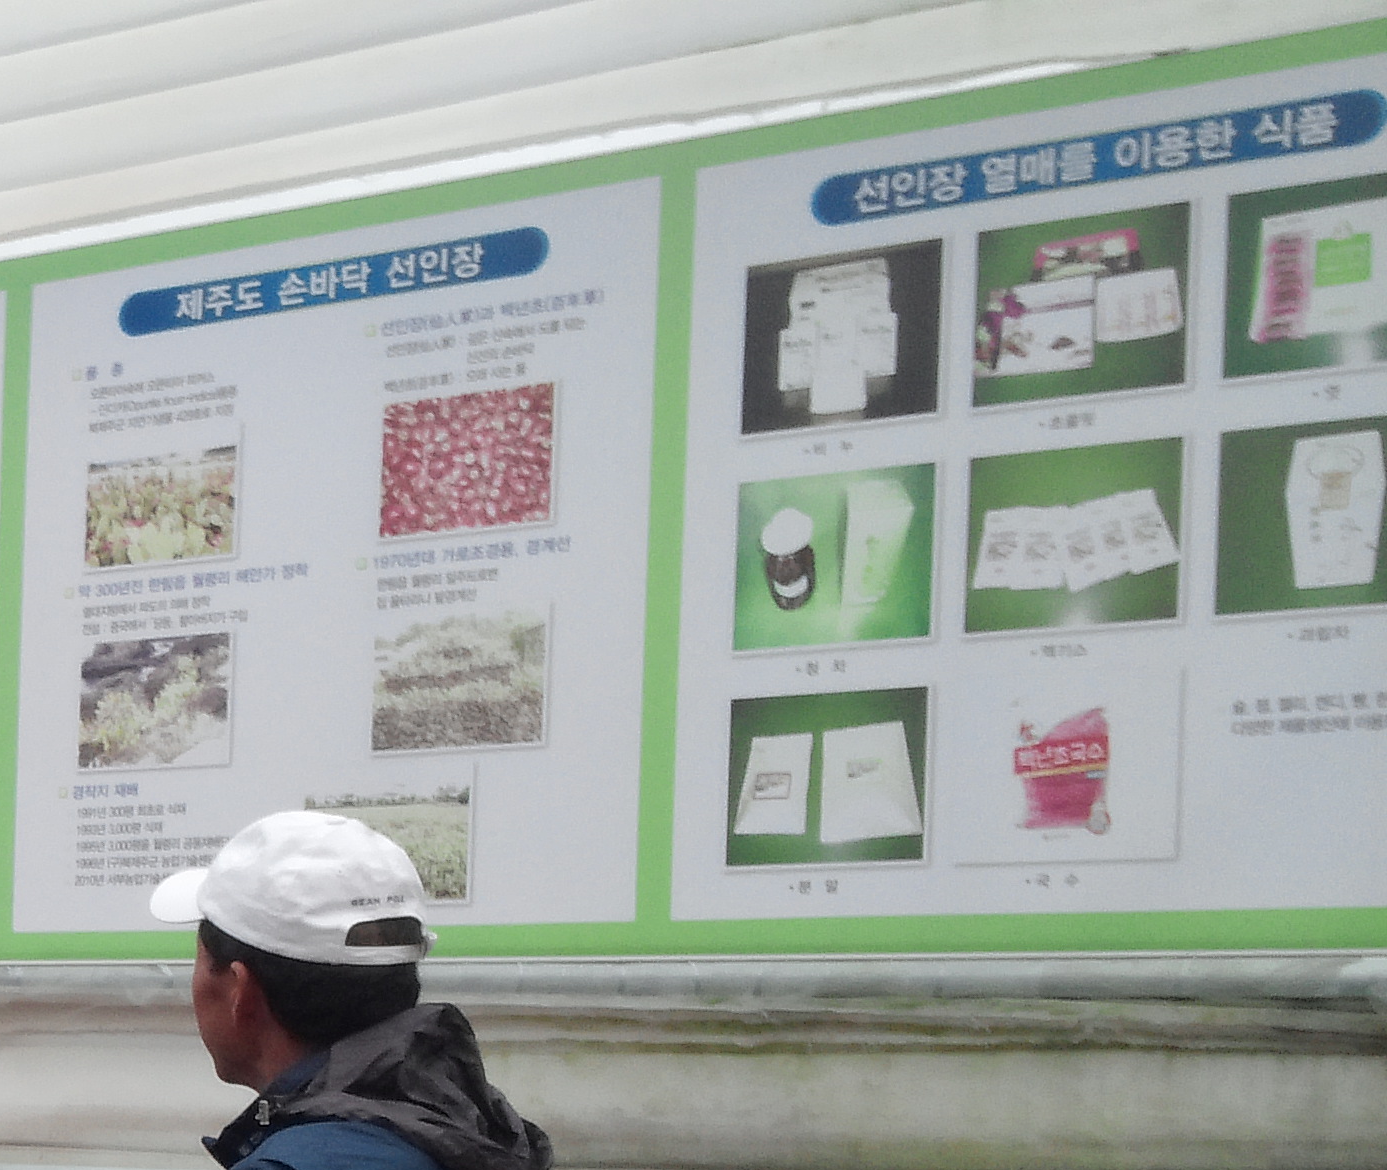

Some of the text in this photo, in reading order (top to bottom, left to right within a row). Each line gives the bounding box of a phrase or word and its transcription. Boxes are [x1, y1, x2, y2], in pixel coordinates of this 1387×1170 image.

[854, 103, 1339, 213] 선인장 열매를 이용한 식품
[176, 243, 484, 320] 제주도 손바닥 선인장
